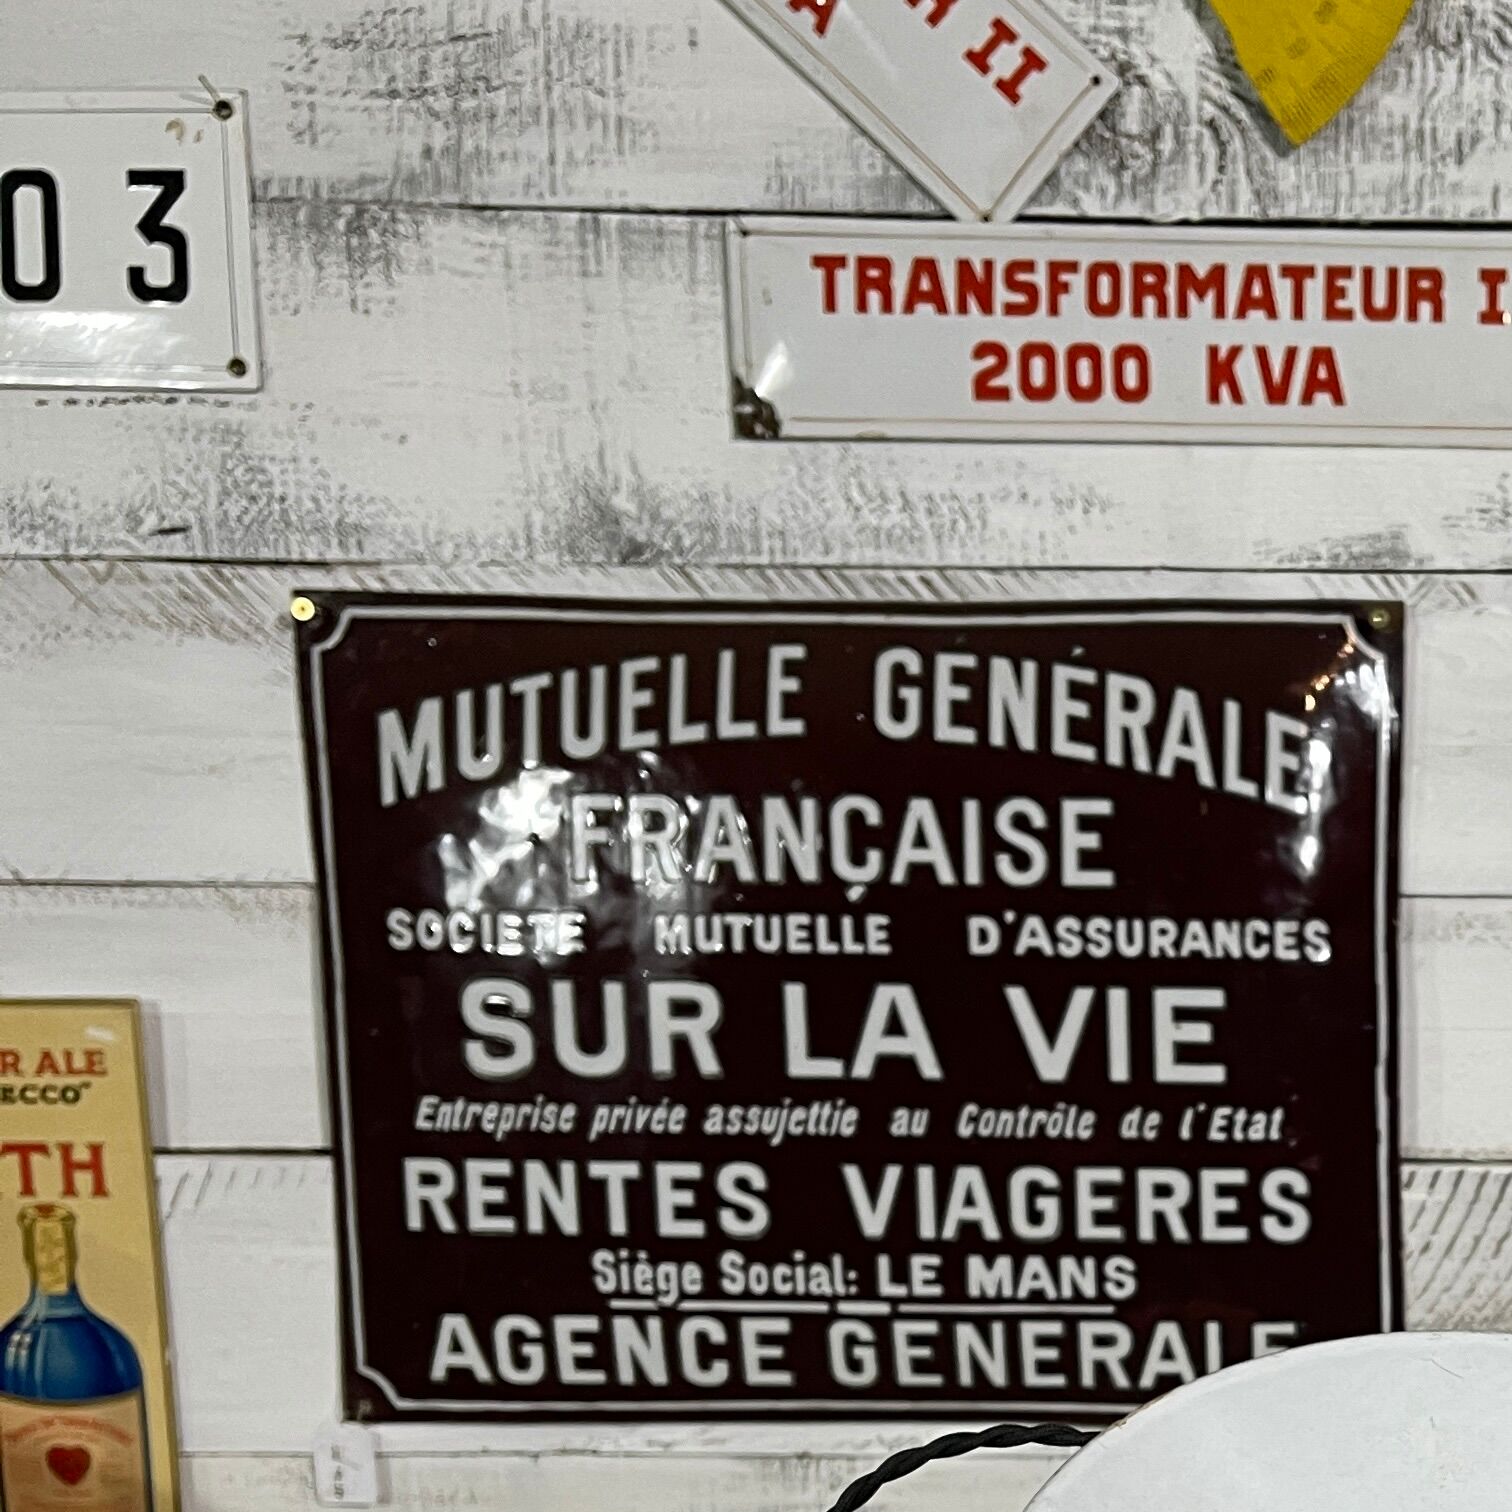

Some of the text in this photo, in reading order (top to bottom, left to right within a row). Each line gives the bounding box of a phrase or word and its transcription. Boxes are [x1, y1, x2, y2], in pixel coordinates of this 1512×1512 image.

[810, 254, 1509, 325] TRANSFORMATEUR I
[970, 340, 1347, 406] 2000 KVA
[377, 642, 807, 807] MUTUELLE
[568, 793, 1116, 902] FRANÇAISE
[654, 914, 893, 956] MUTUELLE
[966, 910, 1332, 962] D'ASSURANCES
[34, 1049, 108, 1077] ALE
[460, 977, 1228, 1084] SUR LA VIE
[414, 1094, 577, 1142] Entreprise
[703, 1099, 860, 1148] assujettie
[889, 1107, 930, 1137] au
[955, 1103, 1097, 1141] Contrôle
[1119, 1104, 1163, 1141] de
[403, 1157, 1312, 1244] RENTES VIAGERES
[591, 1248, 1138, 1306] Siège Social: LE MANS
[428, 1312, 797, 1388] AGENCE
